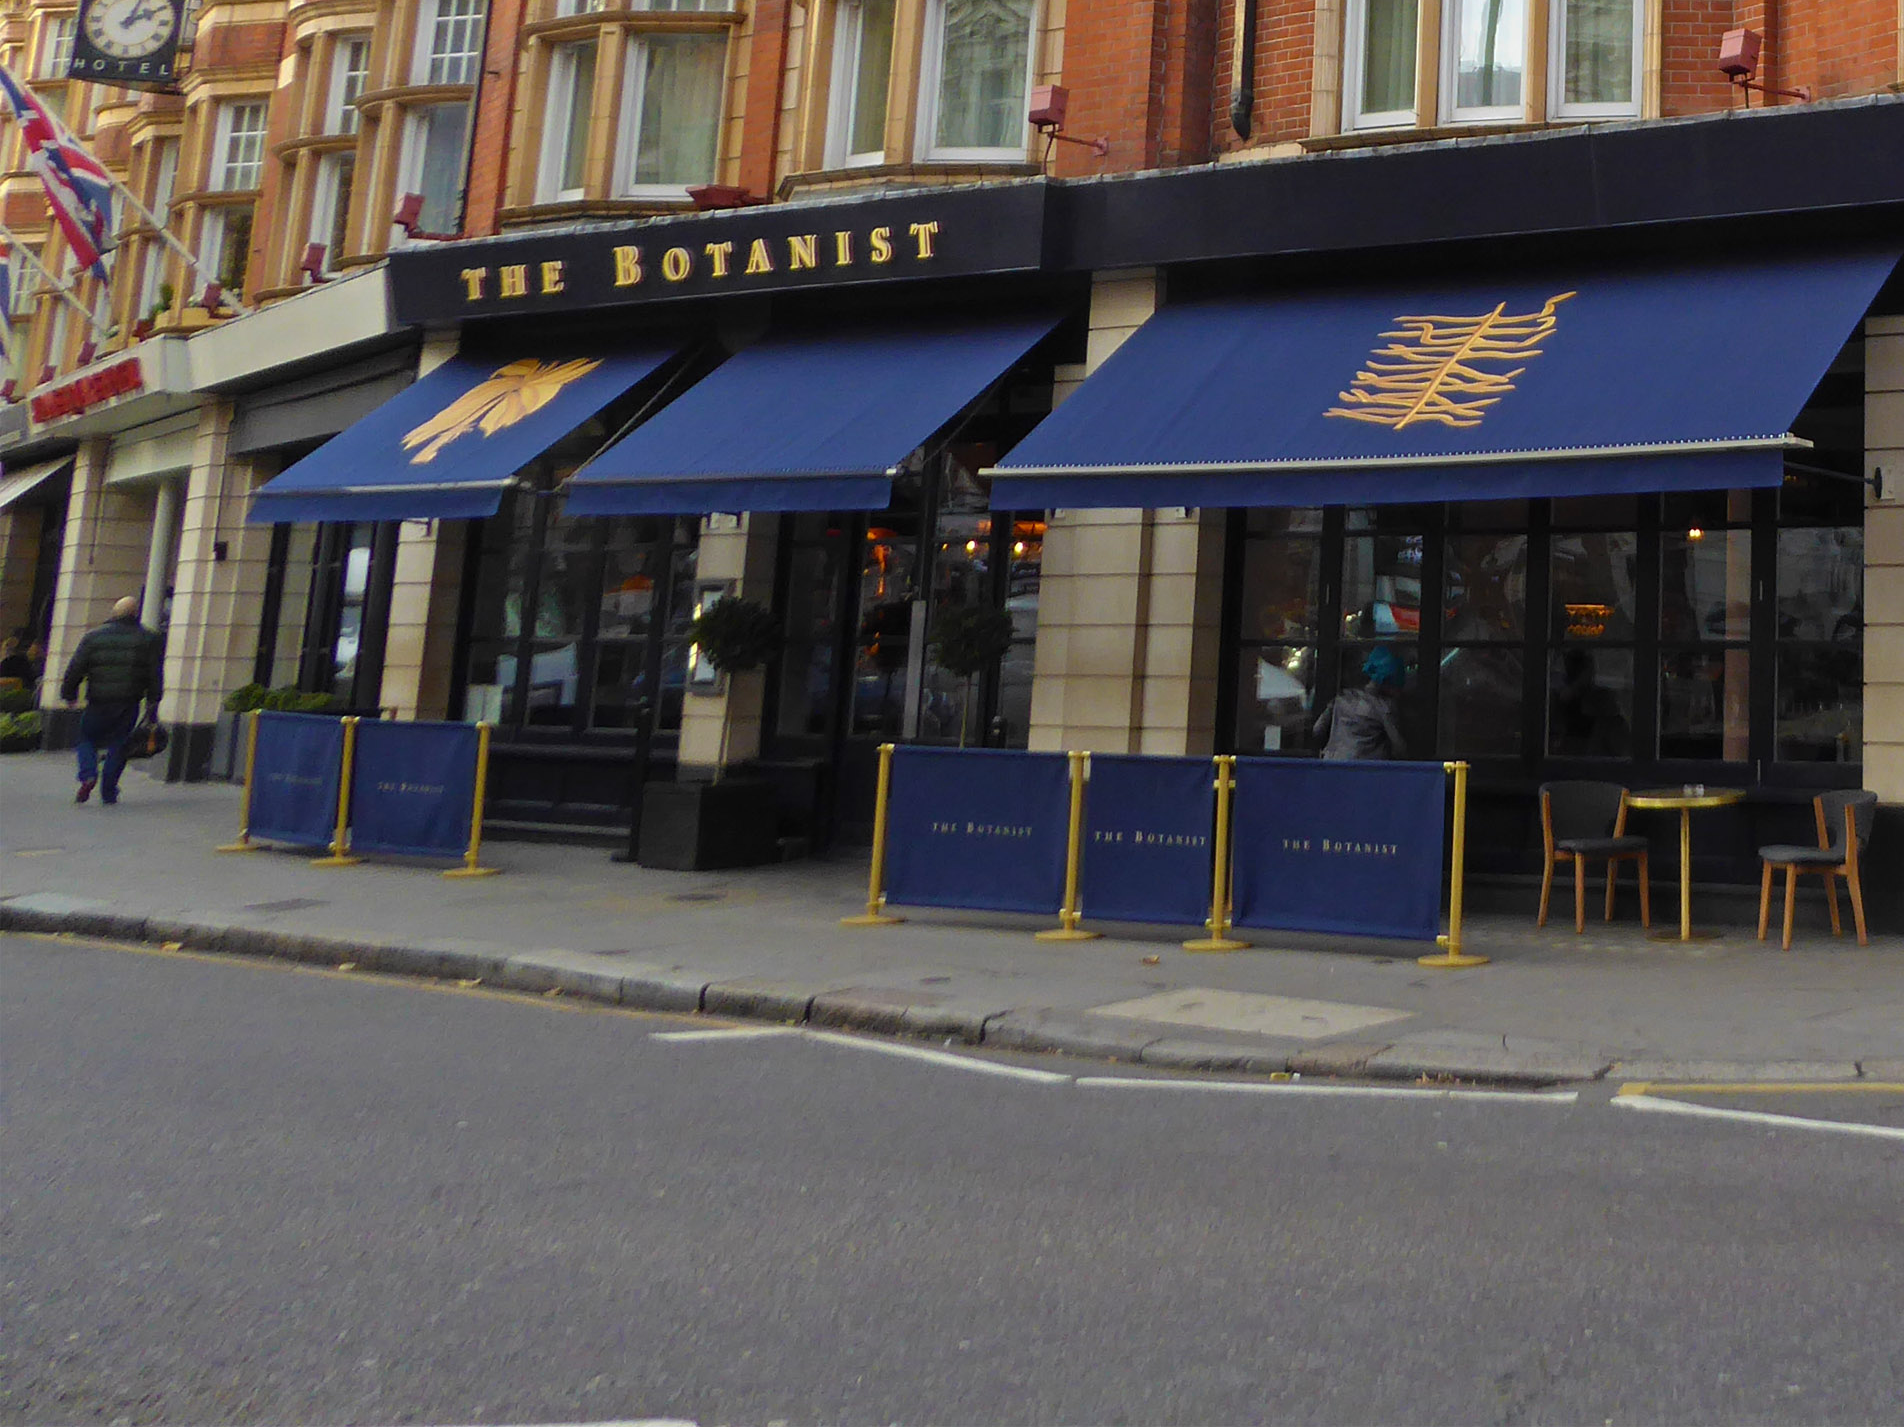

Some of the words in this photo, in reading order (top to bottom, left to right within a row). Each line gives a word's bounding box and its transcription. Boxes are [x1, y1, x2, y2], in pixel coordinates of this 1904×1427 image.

[74, 59, 168, 75] HOTEL
[460, 260, 565, 301] THE
[612, 220, 939, 288] BOTANIST
[931, 822, 957, 833] THE
[967, 822, 1033, 837] BOTANIST
[1094, 830, 1124, 842] THE
[1135, 830, 1208, 846] BOTANIST
[1282, 838, 1311, 851] THE
[1322, 839, 1398, 855] BOTANIST
